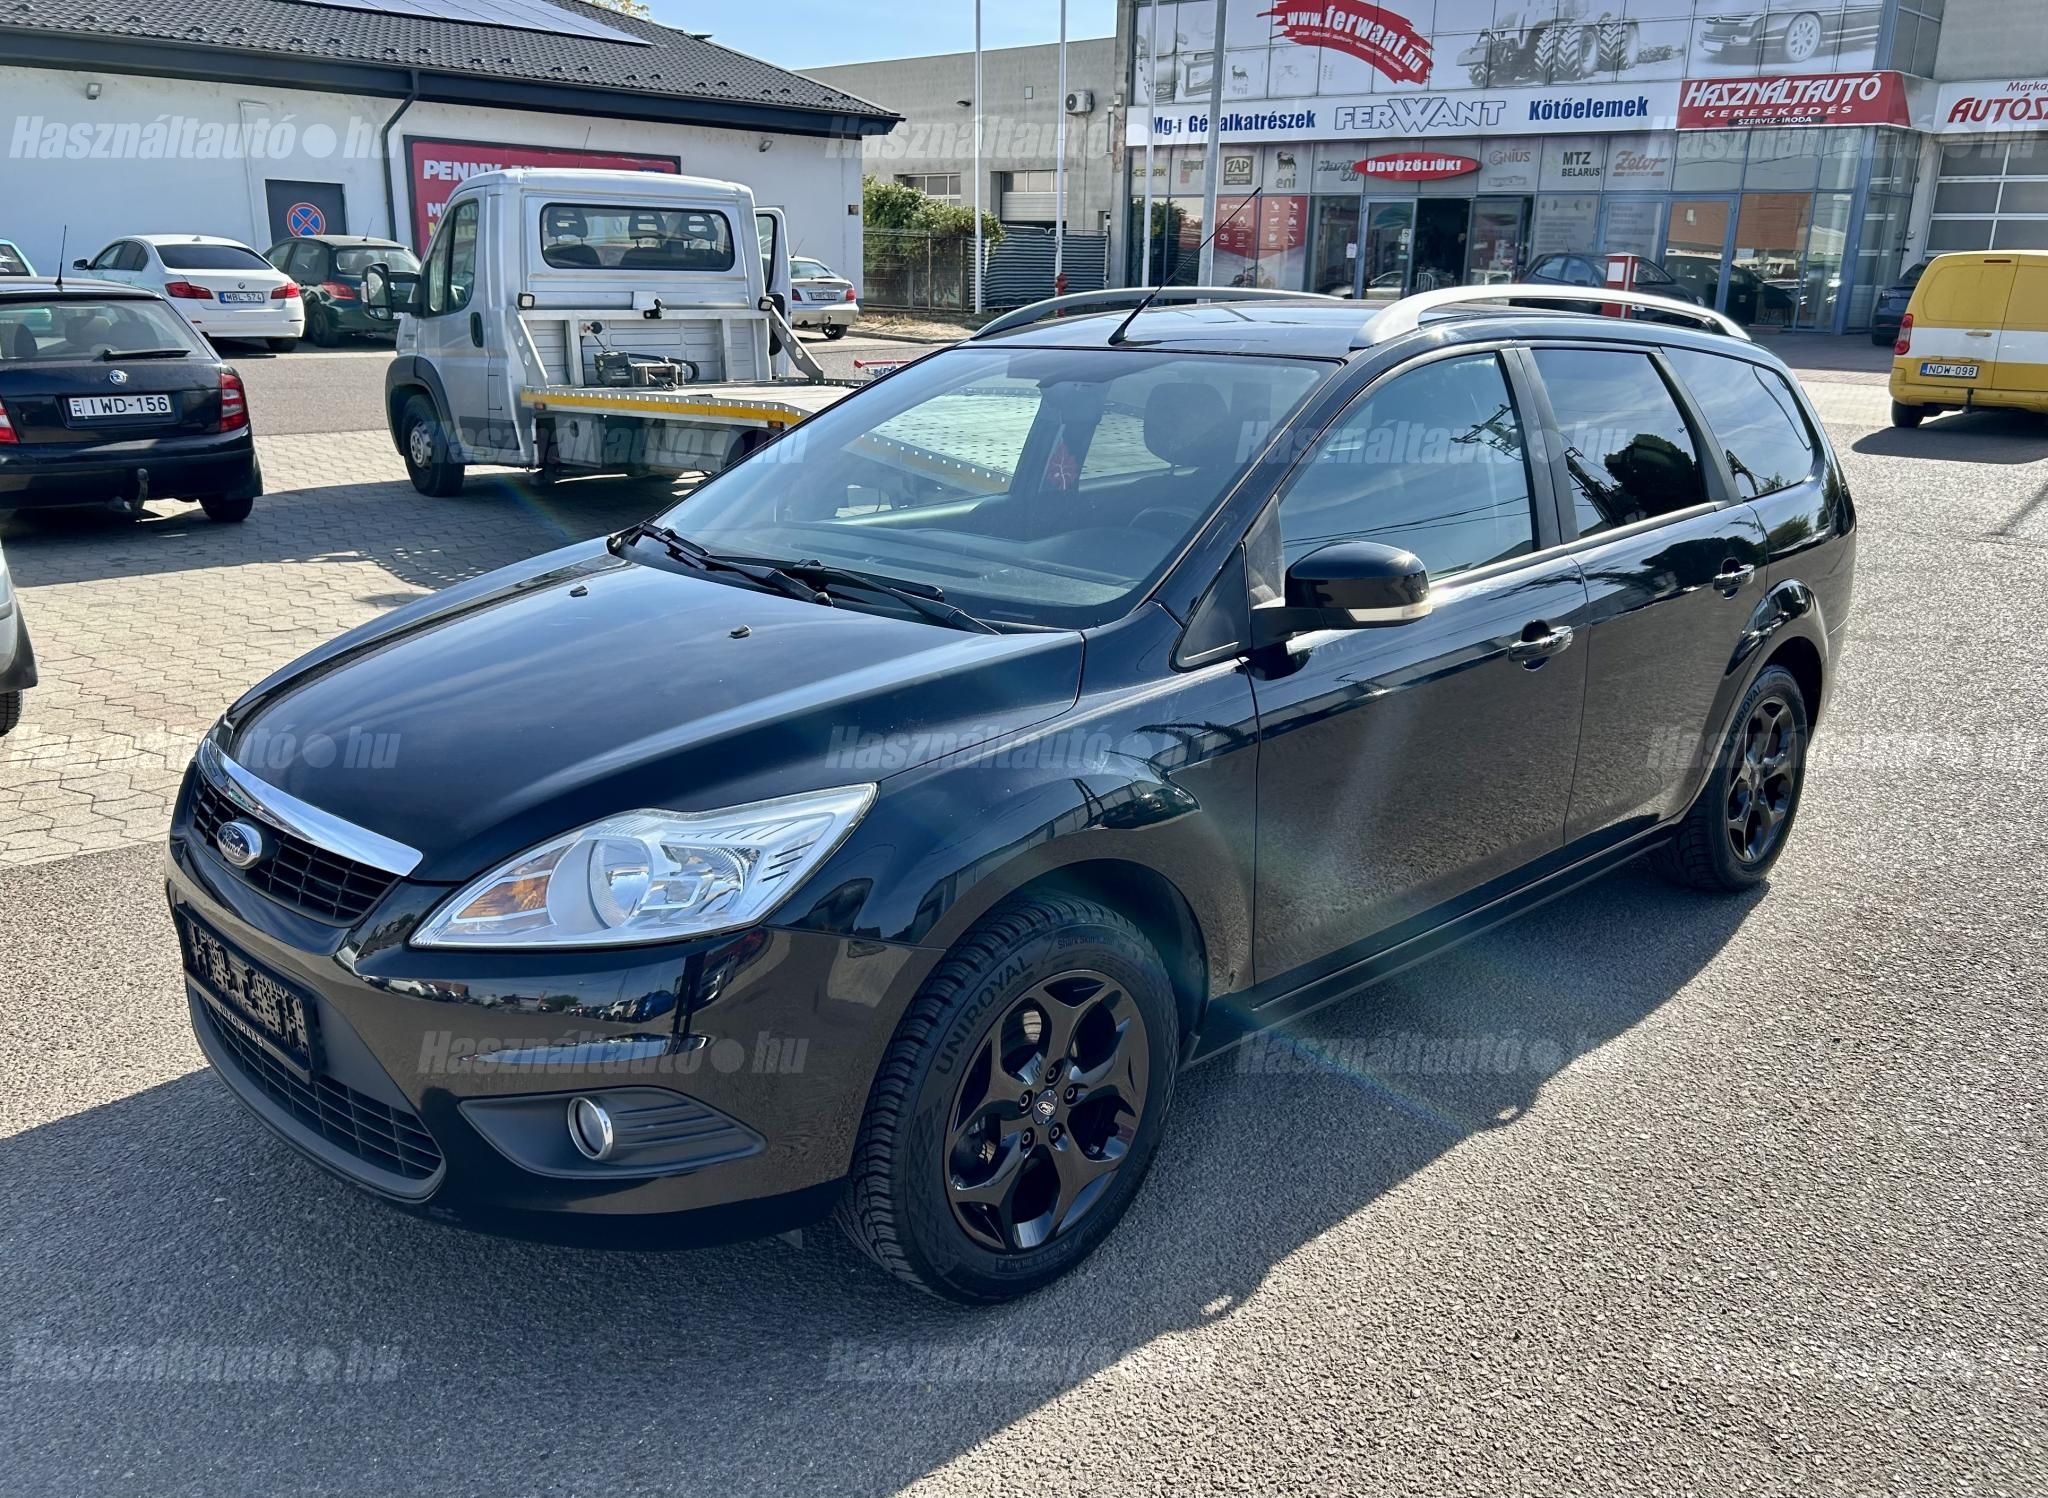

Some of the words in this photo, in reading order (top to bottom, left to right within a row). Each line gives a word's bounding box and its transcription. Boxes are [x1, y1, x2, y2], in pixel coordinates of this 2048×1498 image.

[1287, 5, 1424, 73] www.ferwant.hu
[1682, 73, 1881, 108] HASZNÁLTAUTÓ
[2006, 81, 2048, 92] Márka
[1528, 96, 1649, 121] Kötőelemek
[1704, 104, 1853, 118] KERESKEDÉS
[1188, 110, 1317, 133] Géalkatrészek
[1227, 160, 1249, 173] ZAP
[1366, 159, 1462, 172] ÜDVÖZÖLJÜK!
[1562, 152, 1591, 165] MTZ
[1614, 150, 1668, 171] Zetor
[1561, 167, 1600, 177] BELARUS
[1275, 173, 1296, 188] eni
[1928, 365, 1976, 376] NDW-098
[90, 396, 168, 414] IWD-156
[221, 827, 243, 857] Ford
[935, 956, 1033, 1075] UNIROYAL
